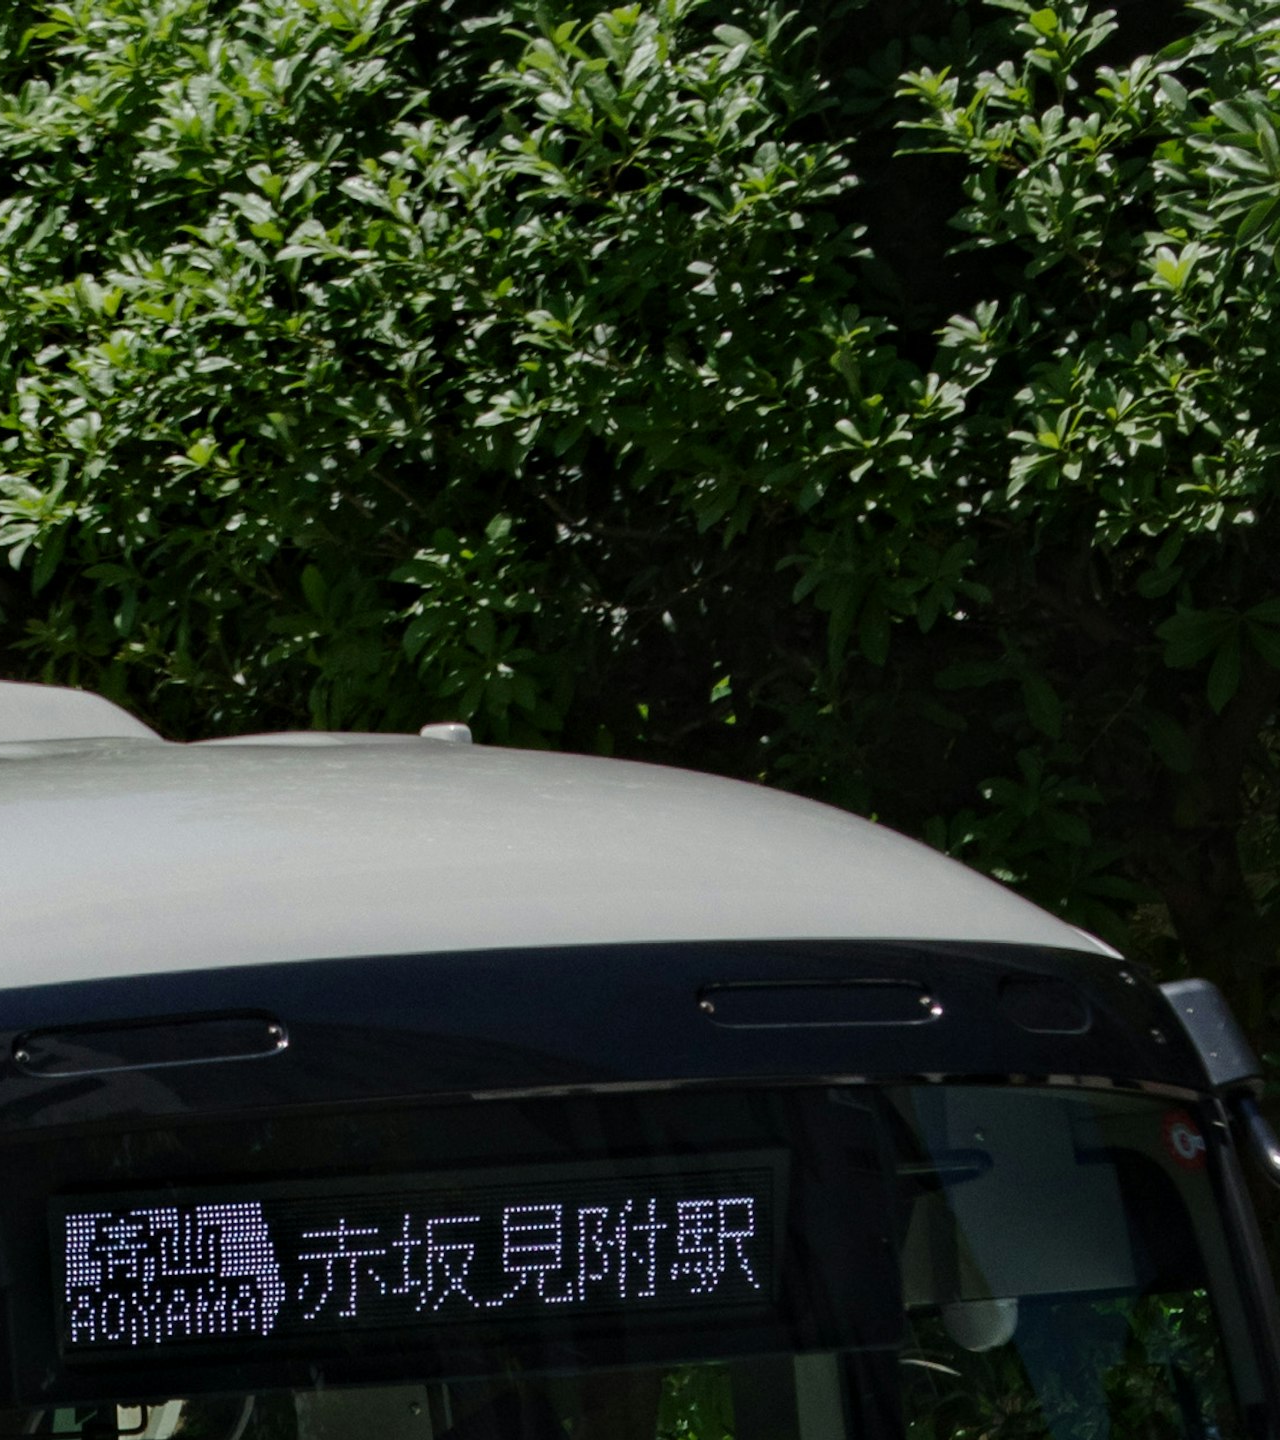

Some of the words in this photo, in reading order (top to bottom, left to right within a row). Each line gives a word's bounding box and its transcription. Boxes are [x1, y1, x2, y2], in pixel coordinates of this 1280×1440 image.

[94, 1215, 217, 1280] 青山
[297, 1197, 762, 1320] 赤坂見附駅
[70, 1284, 258, 1346] AOYAMA
